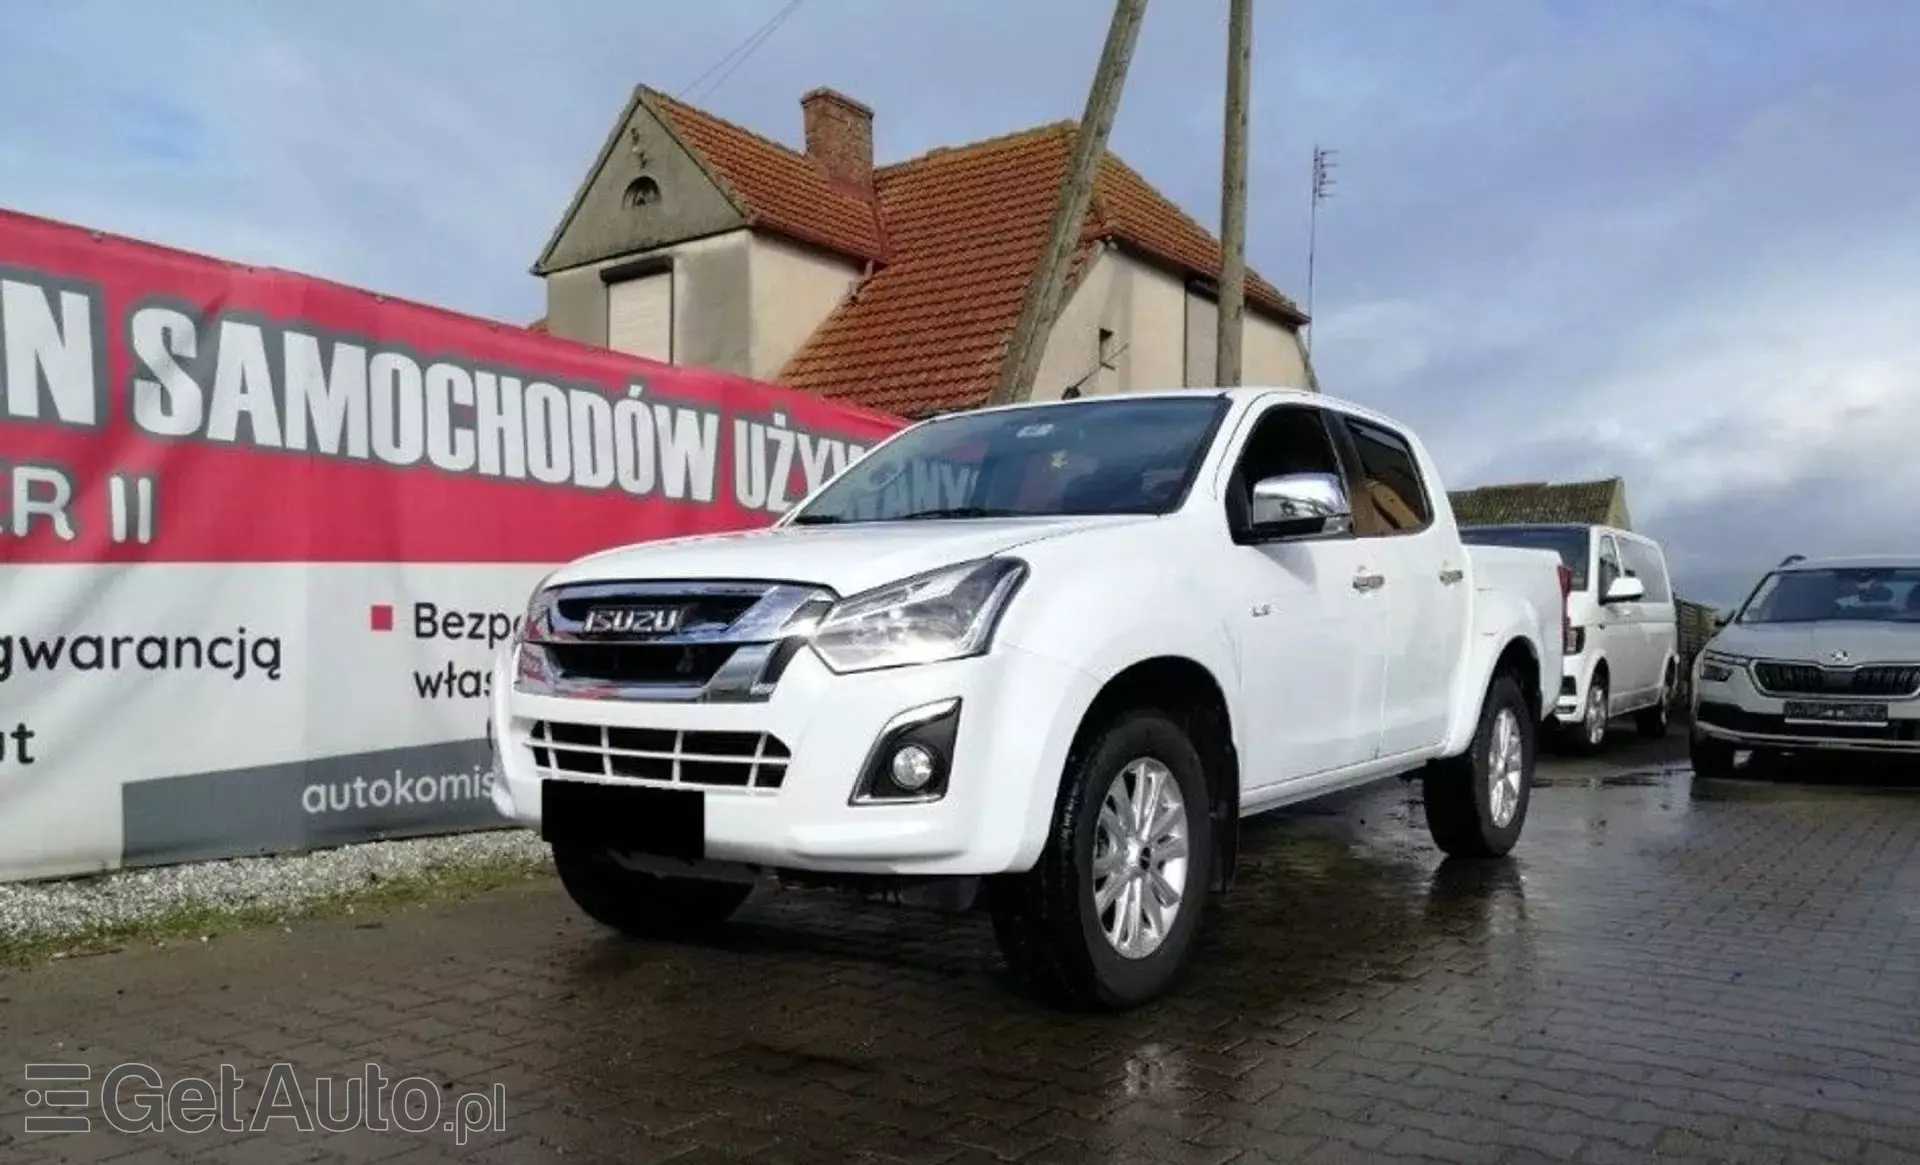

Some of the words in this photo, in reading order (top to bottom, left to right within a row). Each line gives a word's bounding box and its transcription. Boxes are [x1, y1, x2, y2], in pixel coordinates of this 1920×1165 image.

[131, 307, 719, 501] SAMOCHODÓW
[0, 466, 75, 540] R
[583, 609, 678, 633] ISUZU
[0, 723, 35, 764] t
[302, 764, 496, 814] autokomis
